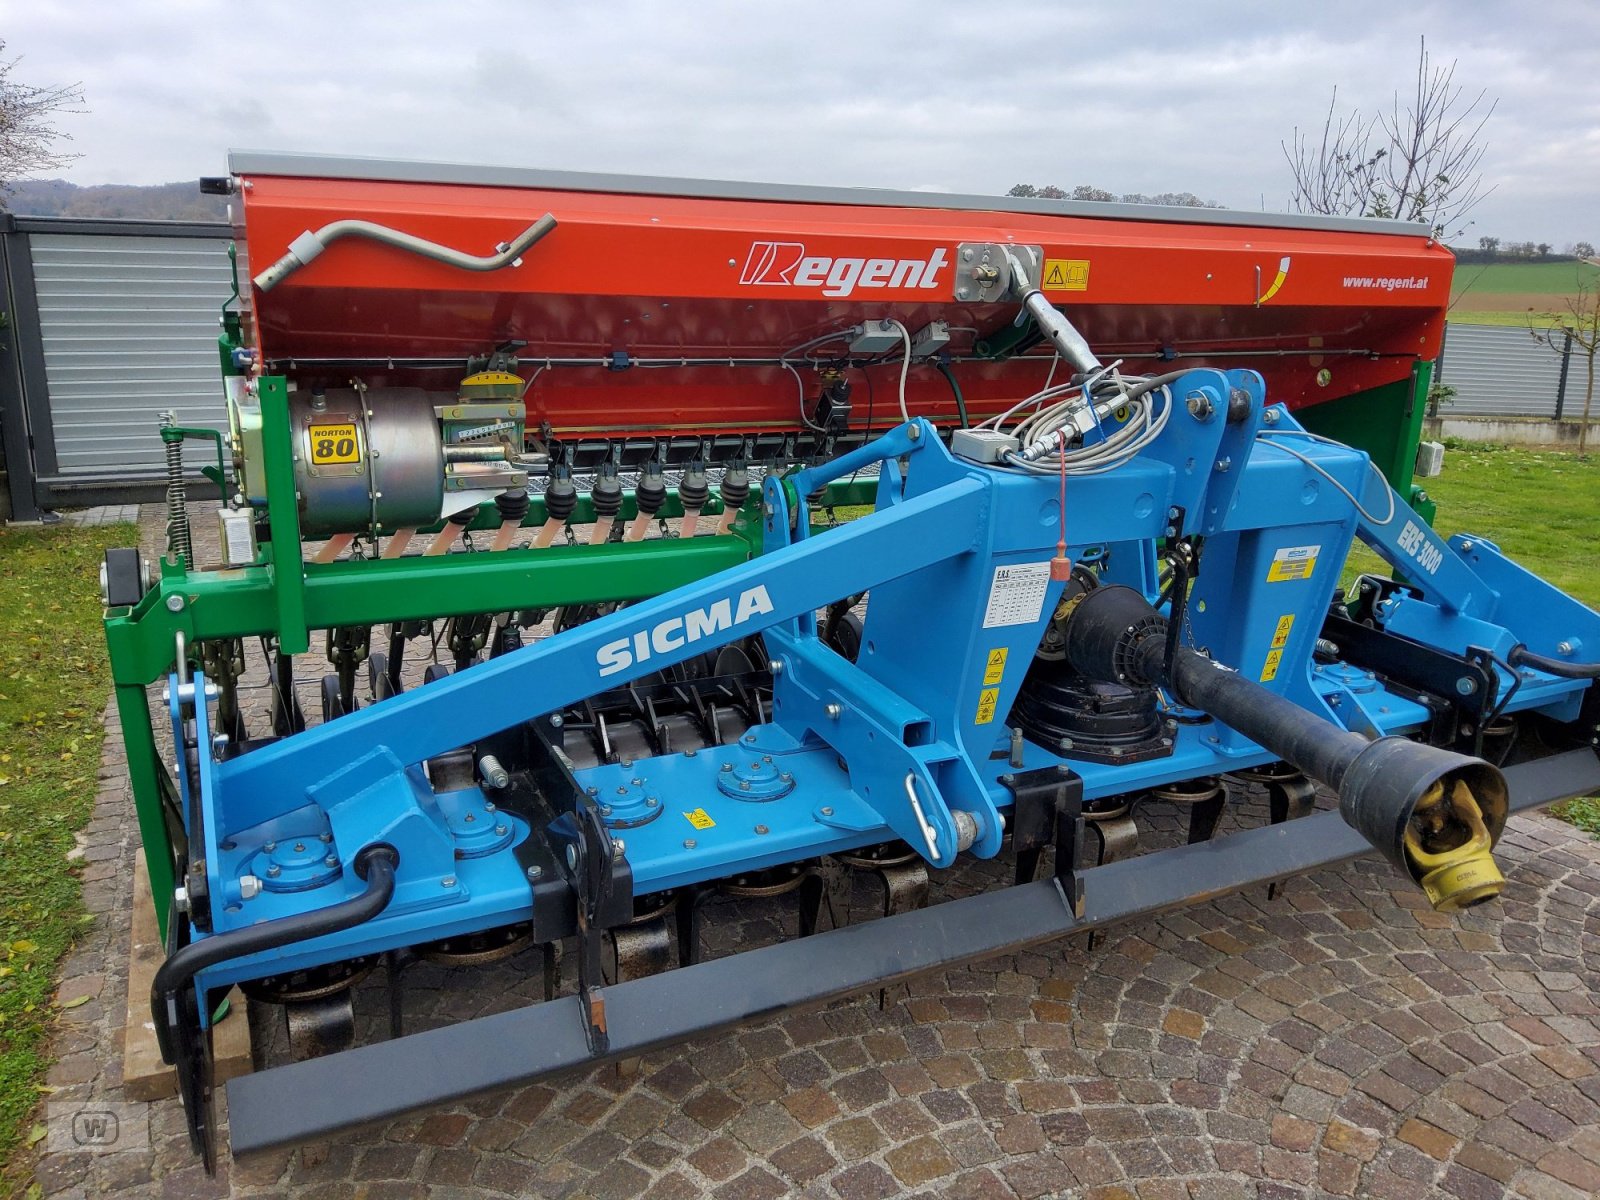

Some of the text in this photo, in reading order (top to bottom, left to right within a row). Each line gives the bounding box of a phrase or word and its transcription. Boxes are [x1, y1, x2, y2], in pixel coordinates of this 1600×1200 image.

[739, 241, 949, 297] Regent
[1342, 276, 1429, 292] www.regent.at
[314, 429, 352, 437] NORTON
[315, 438, 354, 458] 80
[1397, 519, 1443, 575] ERS 3000
[596, 584, 775, 677] SICMA
